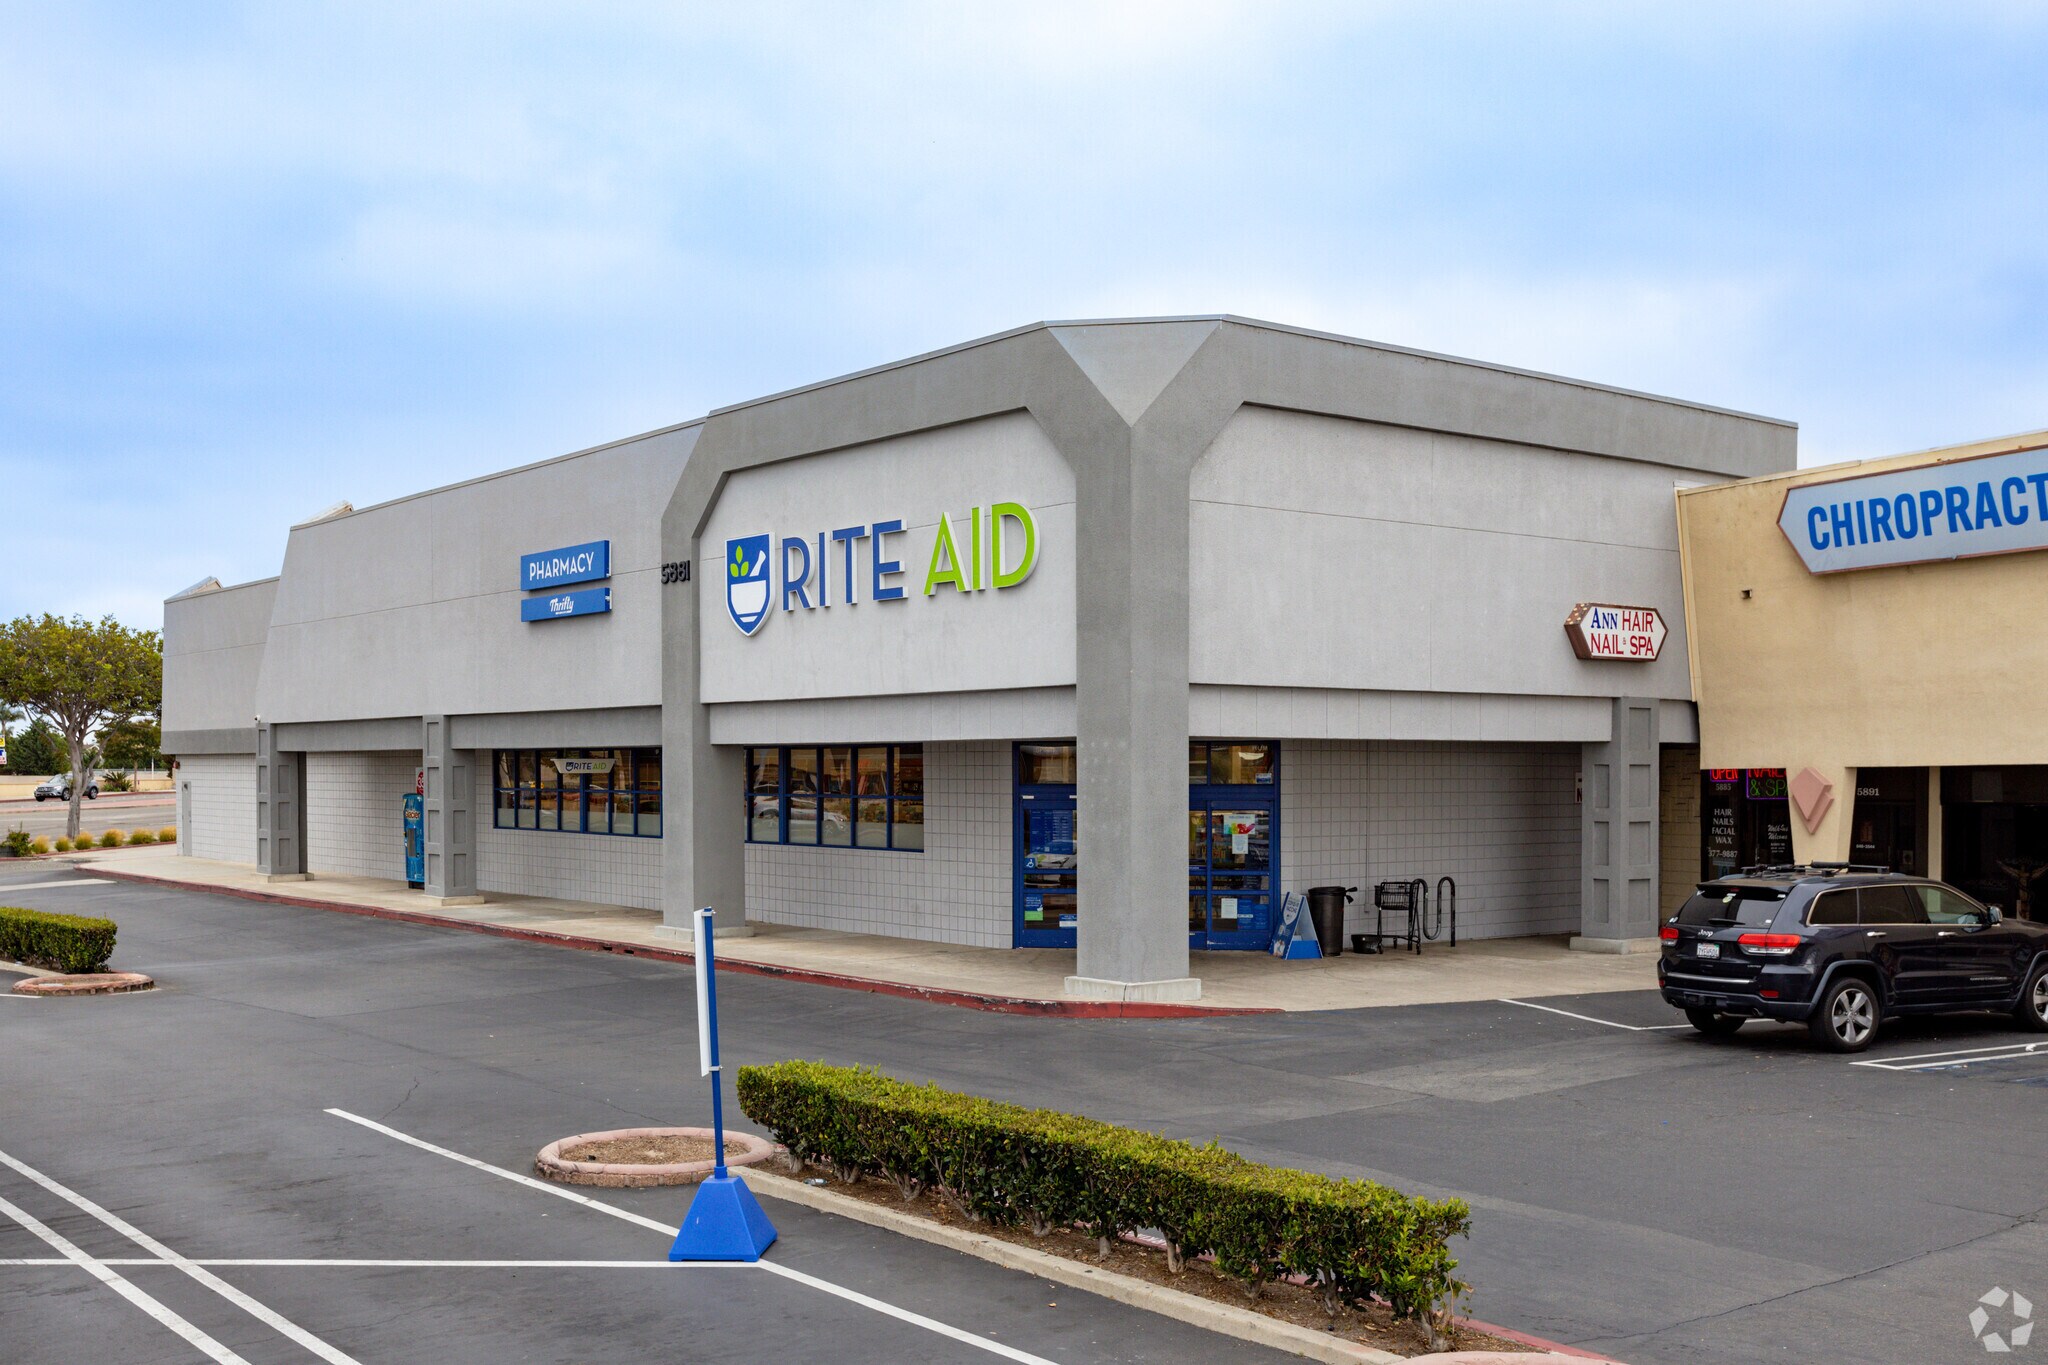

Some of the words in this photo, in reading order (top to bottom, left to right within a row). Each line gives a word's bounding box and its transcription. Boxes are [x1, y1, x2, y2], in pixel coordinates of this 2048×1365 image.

[782, 519, 907, 611] RITE
[923, 502, 1039, 595] AID
[529, 551, 595, 581] PHARMACY
[661, 560, 690, 584] 5881
[1622, 611, 1654, 632] HAIR
[1590, 633, 1624, 655] NAIL
[1629, 635, 1655, 656] SPA
[573, 762, 592, 770] RITE
[592, 762, 607, 770] AID
[1857, 788, 1880, 796] 5891
[1714, 808, 1732, 816] HAIR
[1713, 818, 1734, 826] NAILS
[1711, 827, 1736, 835] FACIAL
[1715, 836, 1733, 844] WAX
